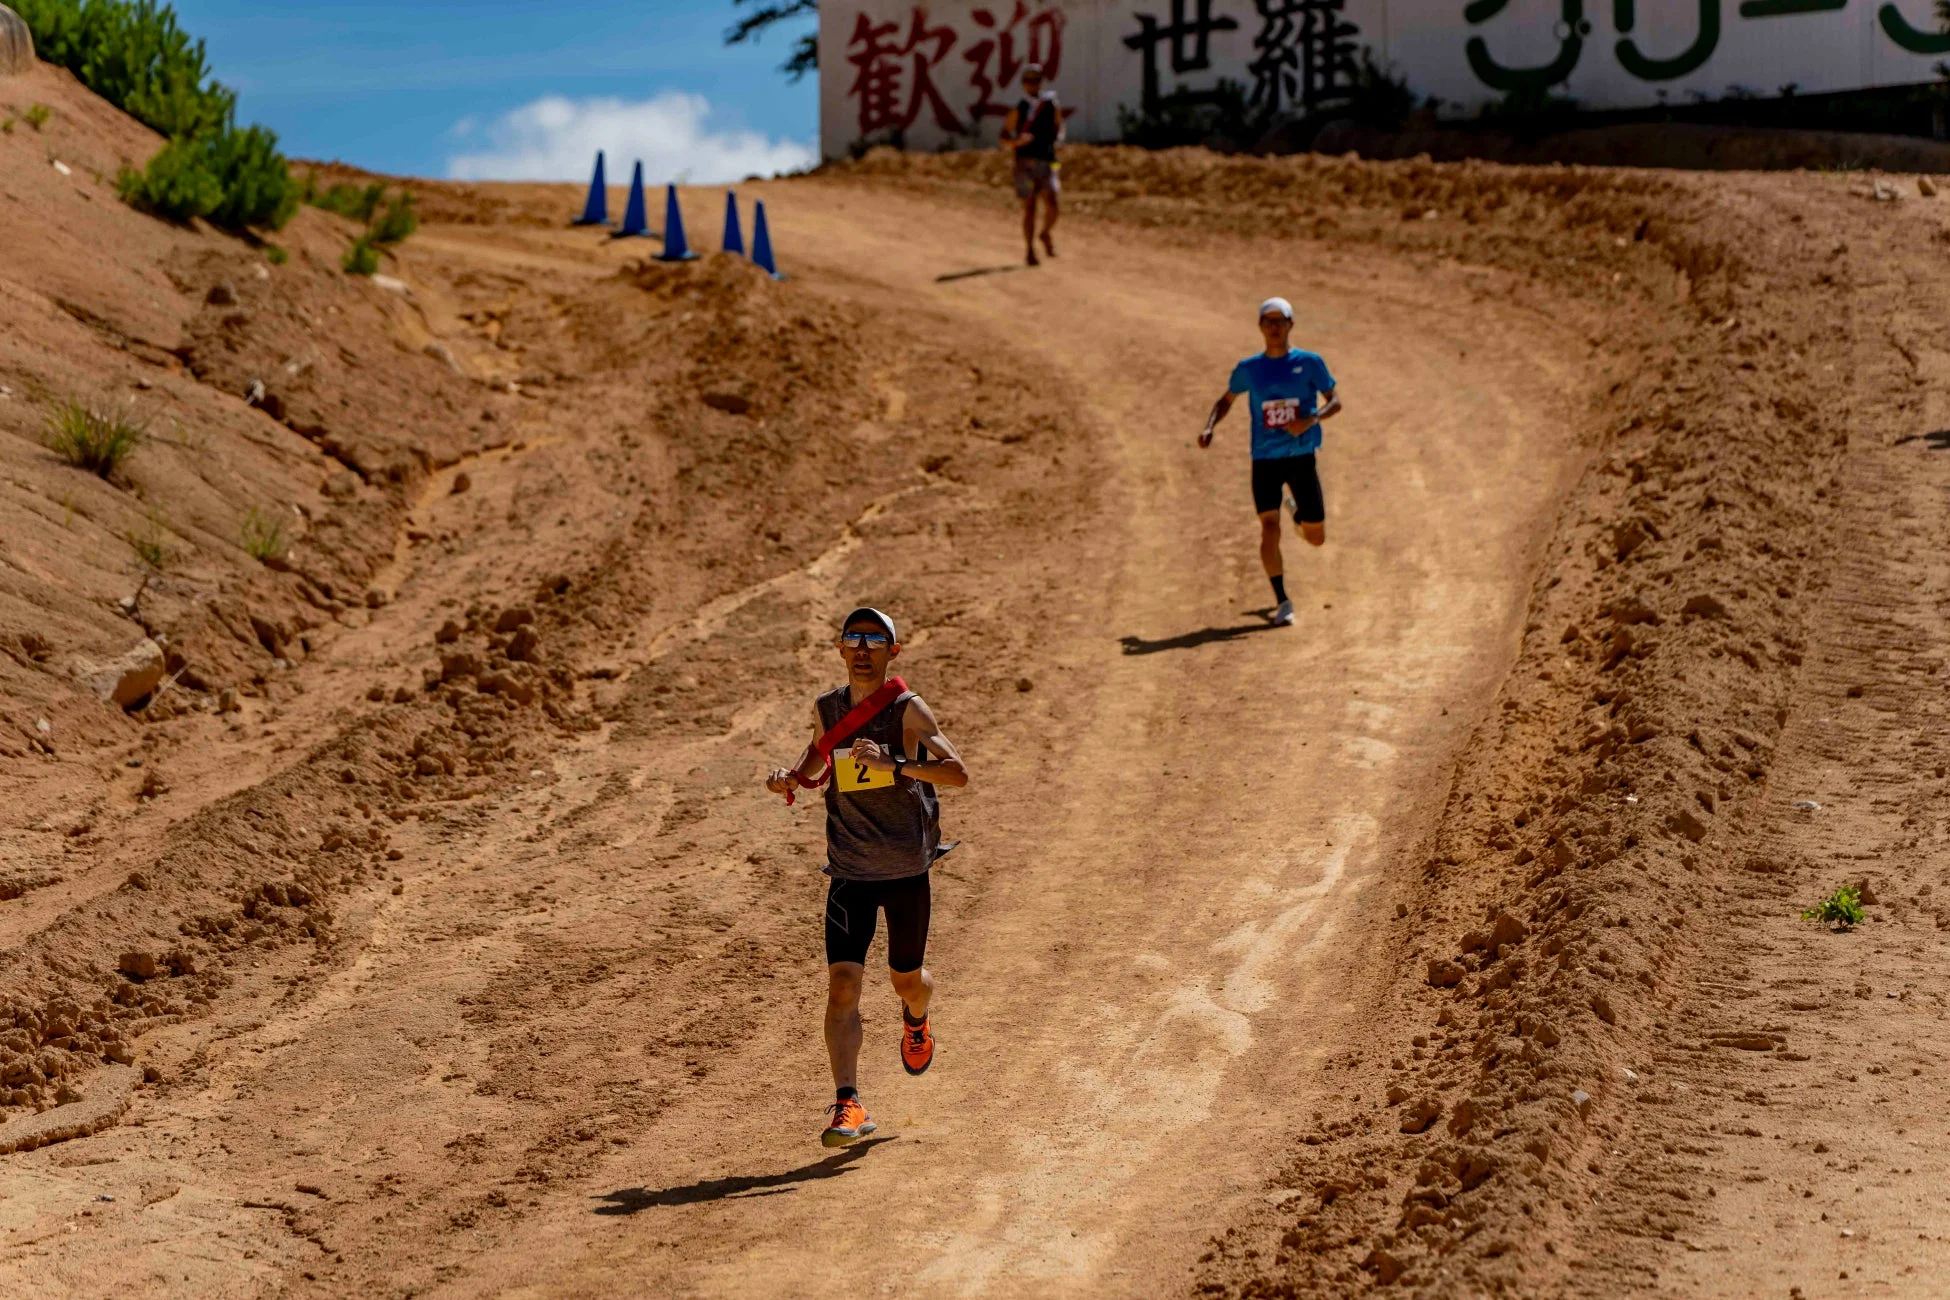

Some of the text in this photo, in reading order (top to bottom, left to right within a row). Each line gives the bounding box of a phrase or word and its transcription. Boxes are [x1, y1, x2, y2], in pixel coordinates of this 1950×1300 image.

[847, 0, 1075, 136] 歓迎
[1465, 0, 1950, 91] グリー
[854, 763, 870, 783] 2
